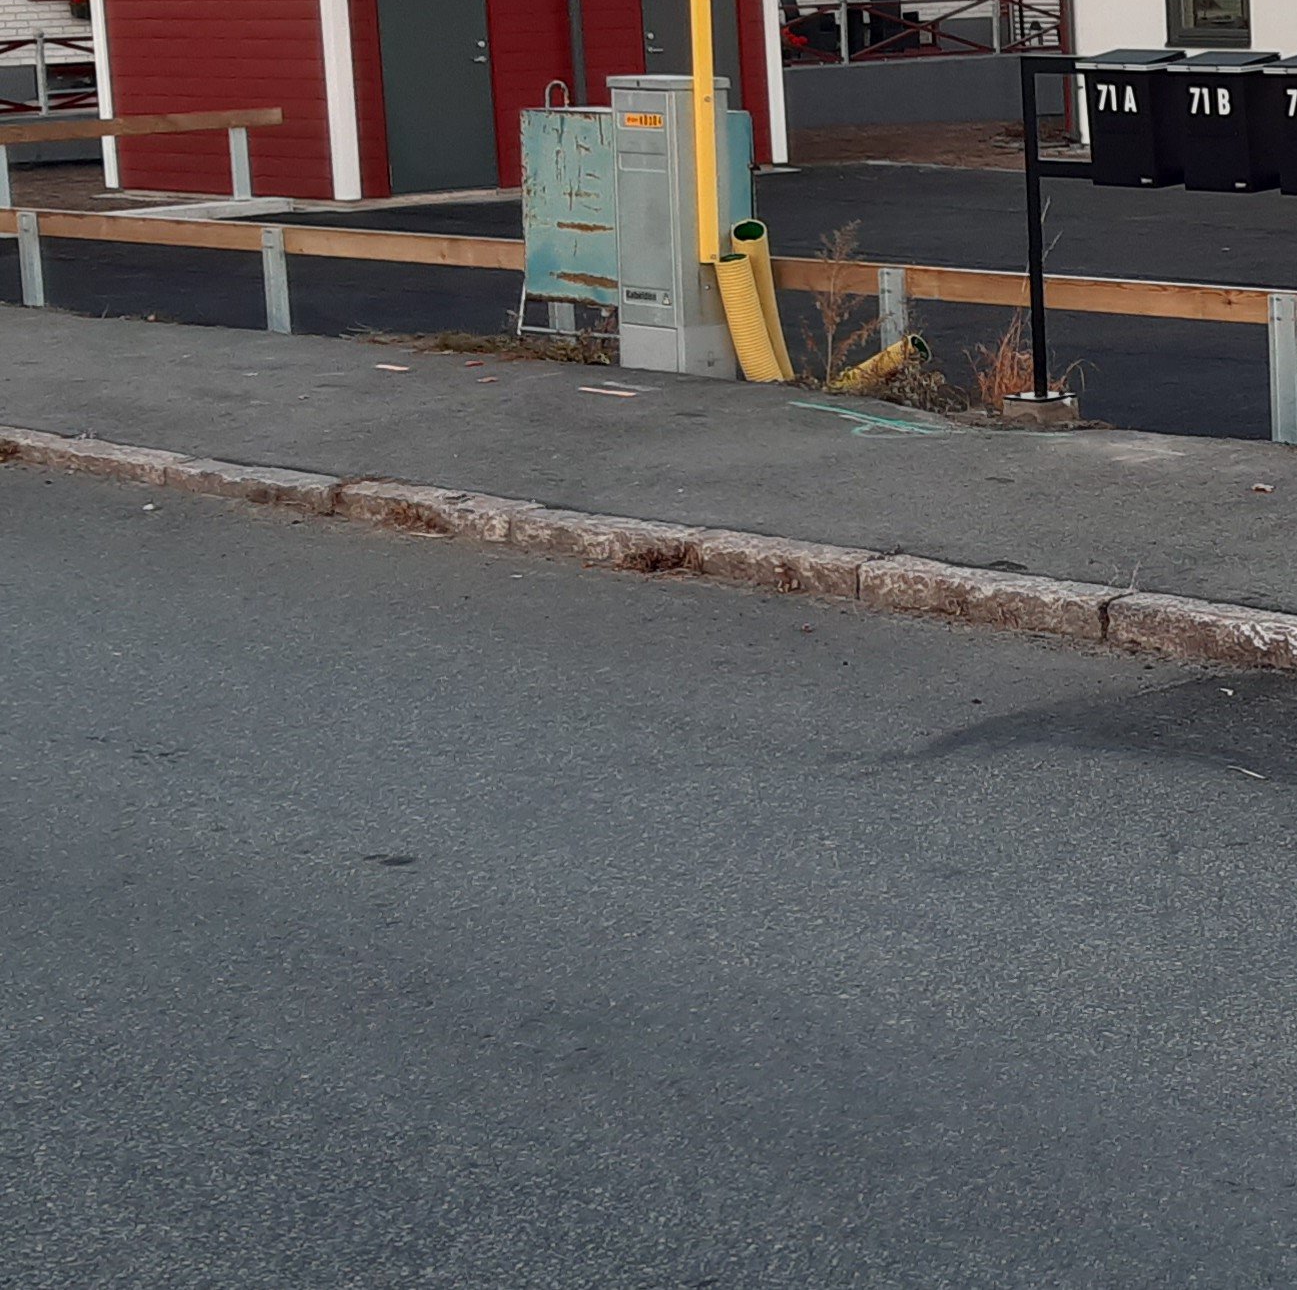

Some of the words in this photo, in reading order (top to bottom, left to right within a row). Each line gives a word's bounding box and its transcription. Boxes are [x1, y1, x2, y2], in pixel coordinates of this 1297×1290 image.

[1097, 83, 1117, 111] 71
[1124, 85, 1137, 112] A
[1189, 87, 1210, 115] 71
[1217, 88, 1231, 115] B
